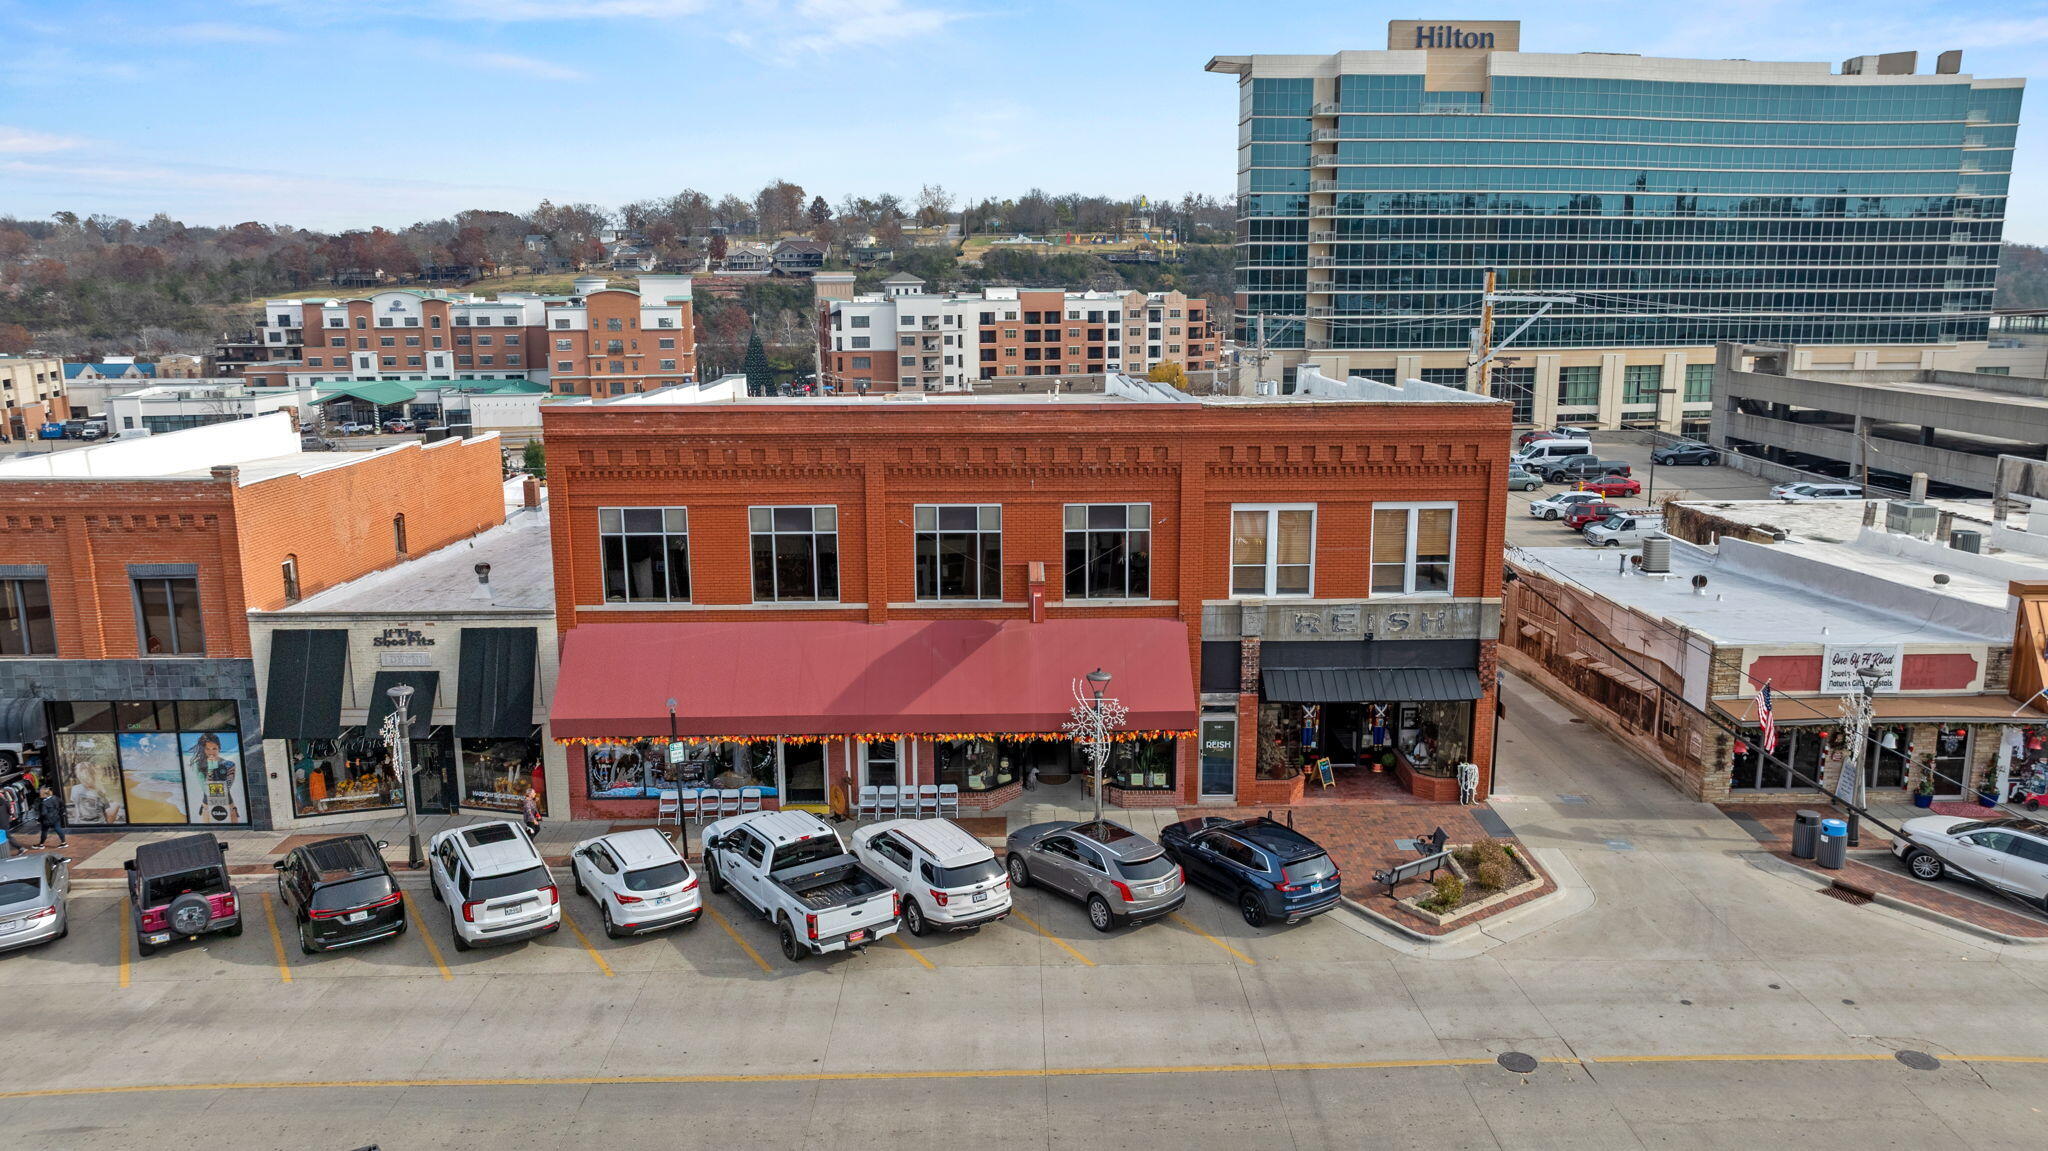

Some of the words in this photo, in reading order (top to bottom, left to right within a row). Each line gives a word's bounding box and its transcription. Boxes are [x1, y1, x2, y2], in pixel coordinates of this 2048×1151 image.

[1415, 25, 1495, 49] Hilton
[1294, 610, 1446, 633] REISH
[373, 637, 407, 647] Shoe
[1832, 653, 1848, 666] One
[1849, 653, 1860, 668] Of
[1861, 653, 1873, 665] A
[1873, 652, 1894, 667] Kind
[1205, 740, 1231, 749] REISH
